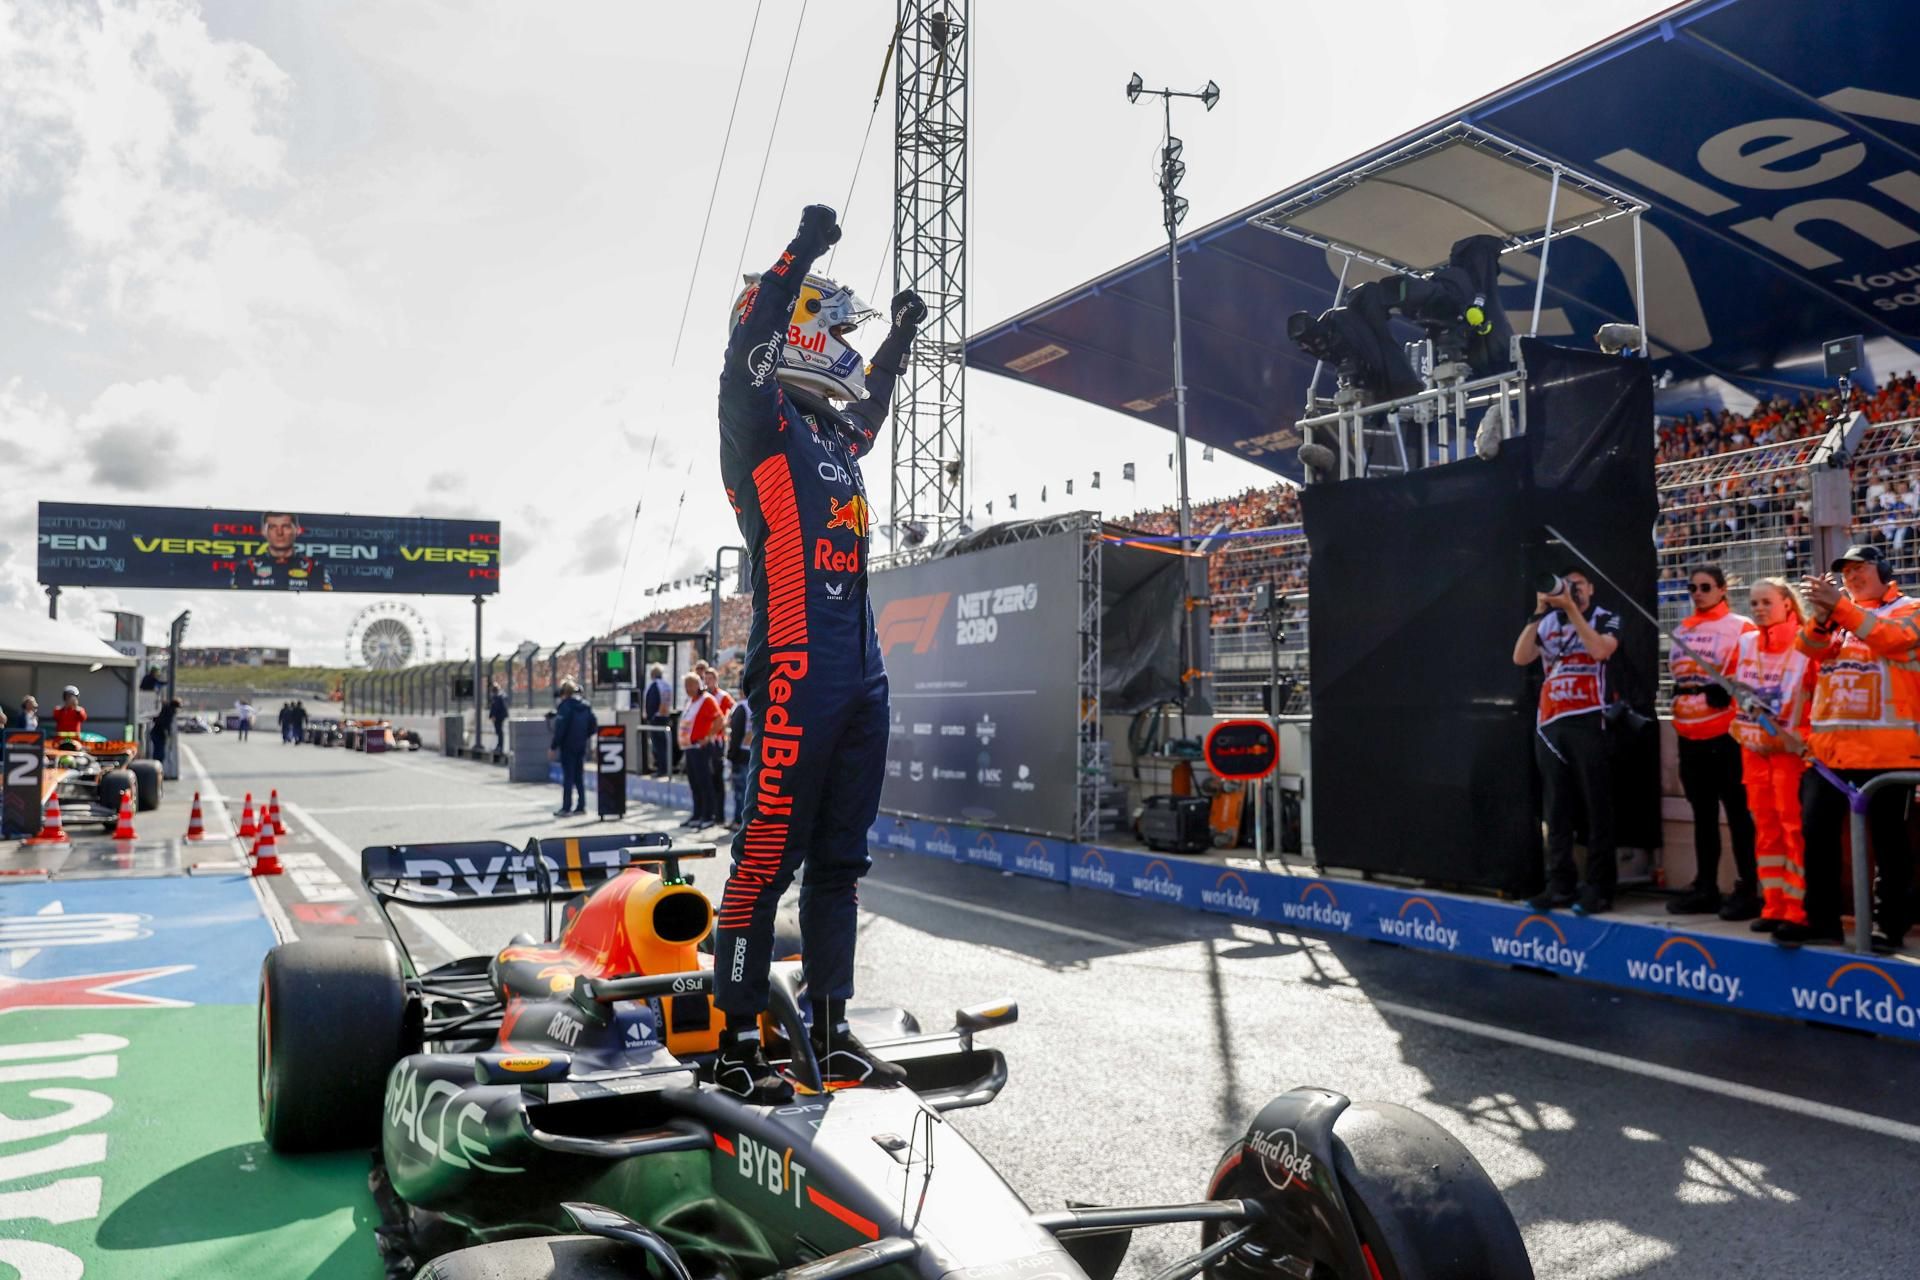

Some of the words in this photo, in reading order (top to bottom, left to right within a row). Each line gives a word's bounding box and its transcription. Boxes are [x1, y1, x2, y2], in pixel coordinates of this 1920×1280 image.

[1872, 284, 1920, 311] so
[765, 331, 783, 363] Hard
[787, 325, 827, 353] Bull
[751, 361, 772, 388] Rock
[814, 538, 859, 573] Red
[957, 590, 992, 620] NET
[992, 582, 1038, 615] ZERO
[956, 616, 998, 646] 2030
[7, 752, 39, 786] 2
[600, 743, 625, 773] 3
[1015, 855, 1055, 877] workday
[1070, 864, 1116, 888] workday
[1132, 875, 1183, 901] workday
[1201, 887, 1259, 916] workday
[1282, 901, 1352, 932] workday
[1379, 915, 1459, 950] workday
[1491, 932, 1587, 975] workday
[1626, 954, 1741, 1002] workday
[733, 937, 748, 983] sparco
[686, 978, 703, 990] Sui
[547, 1011, 584, 1047] ROKT
[384, 1057, 526, 1173] RACLE
[1250, 1130, 1283, 1161] Hard
[738, 1133, 807, 1209] BYBIT
